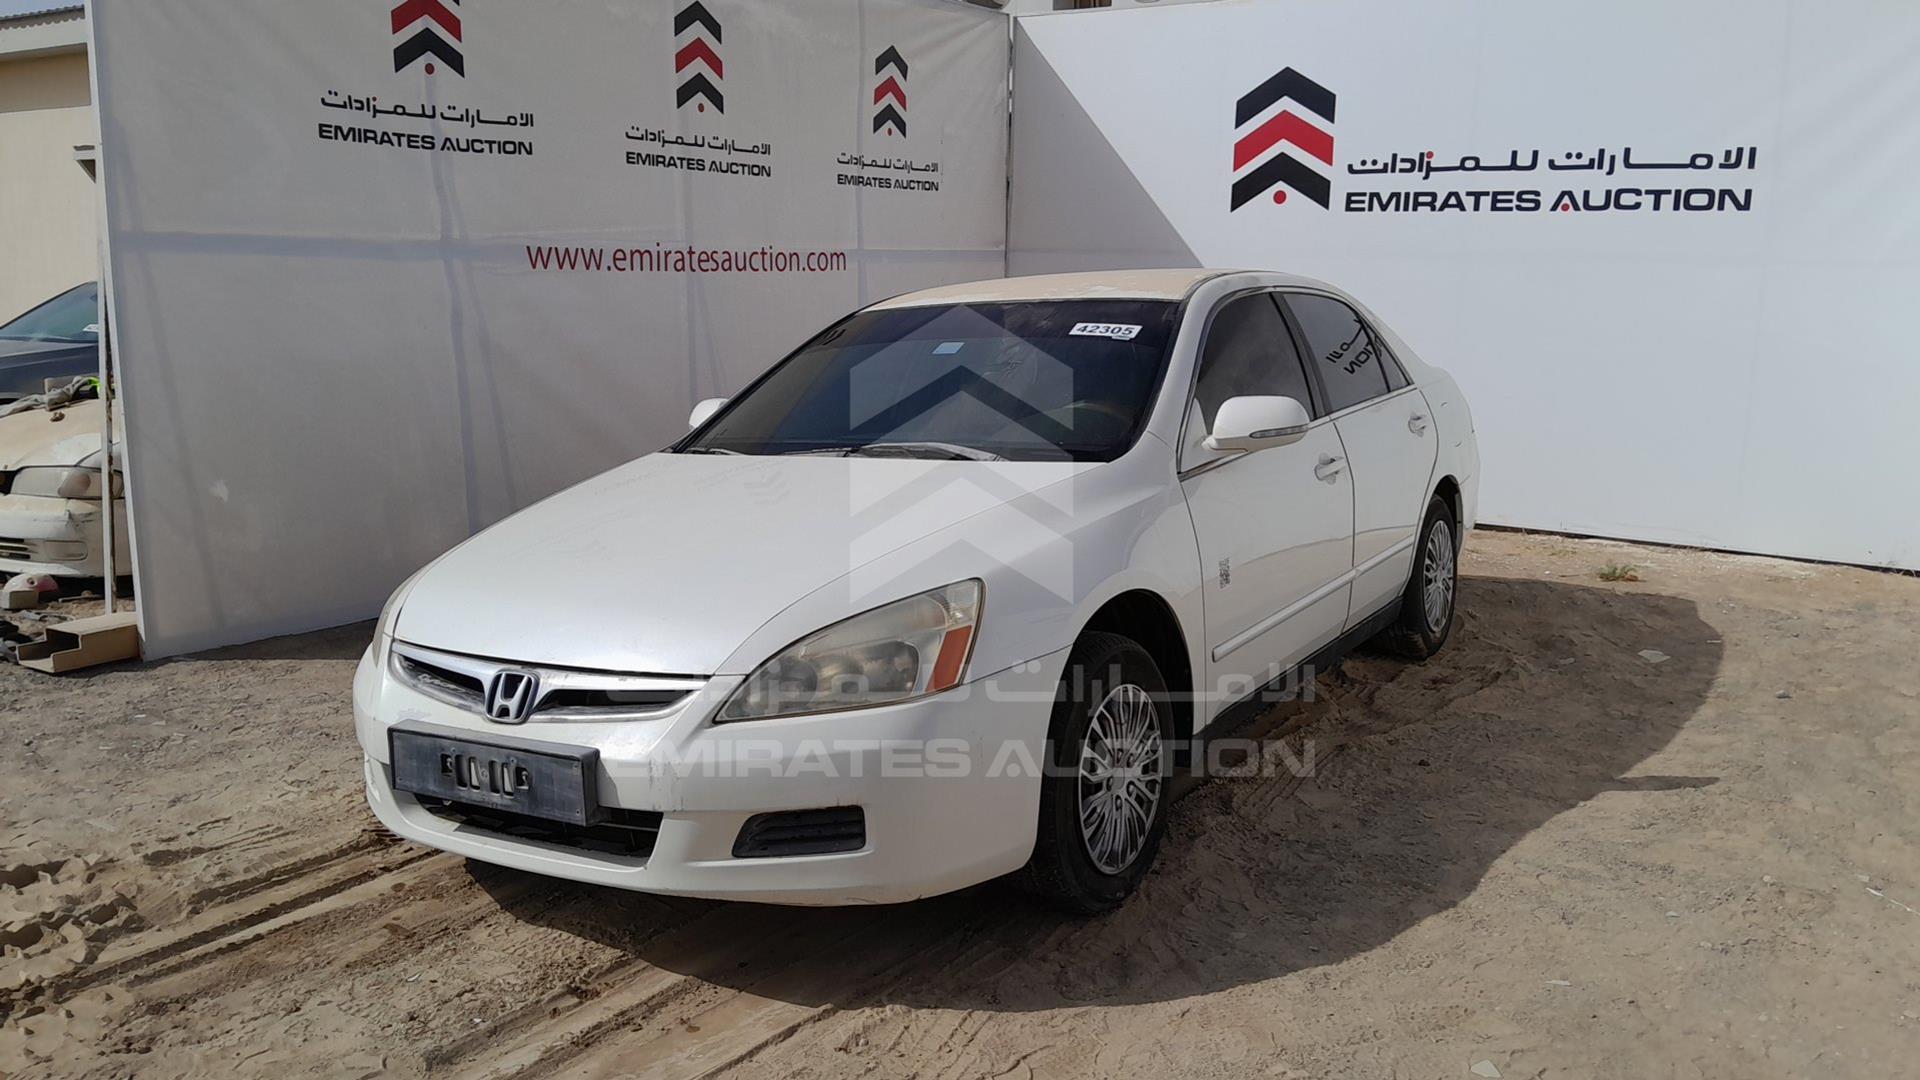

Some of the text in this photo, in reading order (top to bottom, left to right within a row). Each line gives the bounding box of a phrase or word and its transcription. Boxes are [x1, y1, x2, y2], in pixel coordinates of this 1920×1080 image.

[320, 89, 436, 119] للمزادات
[318, 122, 533, 156] EMIRATES AUCTION
[625, 151, 771, 178] EMIRATES AUCTION
[1347, 149, 1540, 181] للمزادات
[837, 173, 939, 191] EMIRATES AUCTION
[1344, 187, 1753, 212] EMIRATES AUCTION
[526, 241, 847, 273] www.emiratesauction.com
[1076, 324, 1136, 336] 42305
